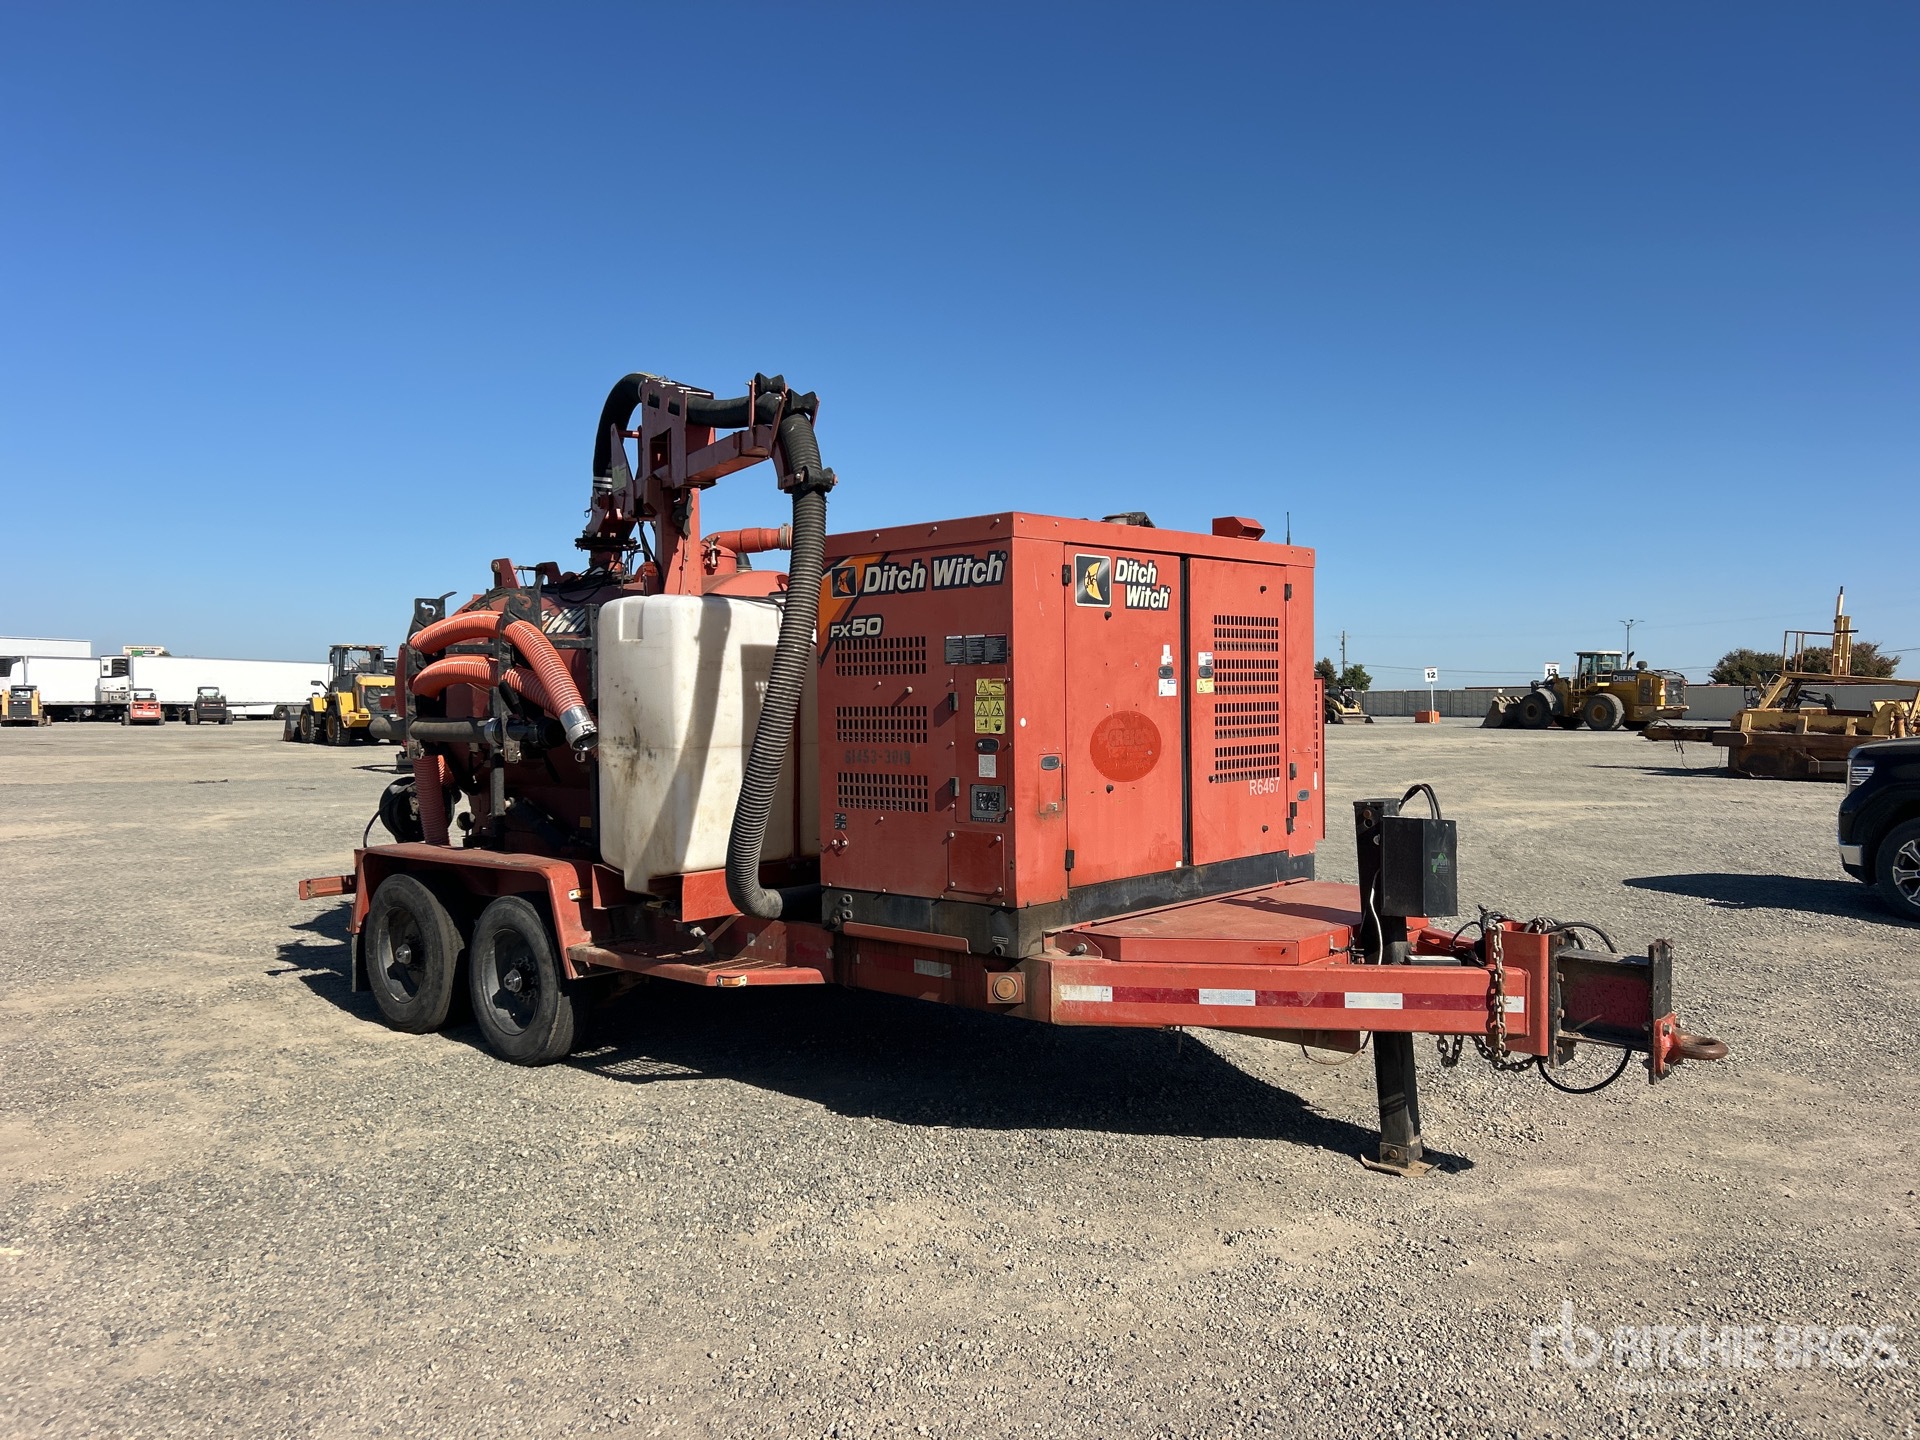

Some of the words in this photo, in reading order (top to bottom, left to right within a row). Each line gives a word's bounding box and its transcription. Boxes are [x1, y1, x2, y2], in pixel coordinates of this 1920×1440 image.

[863, 562, 927, 593] Ditch
[1115, 559, 1157, 584] Ditch
[1126, 585, 1167, 608] Witch
[830, 617, 882, 638] FX50
[1427, 671, 1436, 679] 12
[1613, 674, 1636, 682] DEERE
[1249, 777, 1281, 796] R6467
